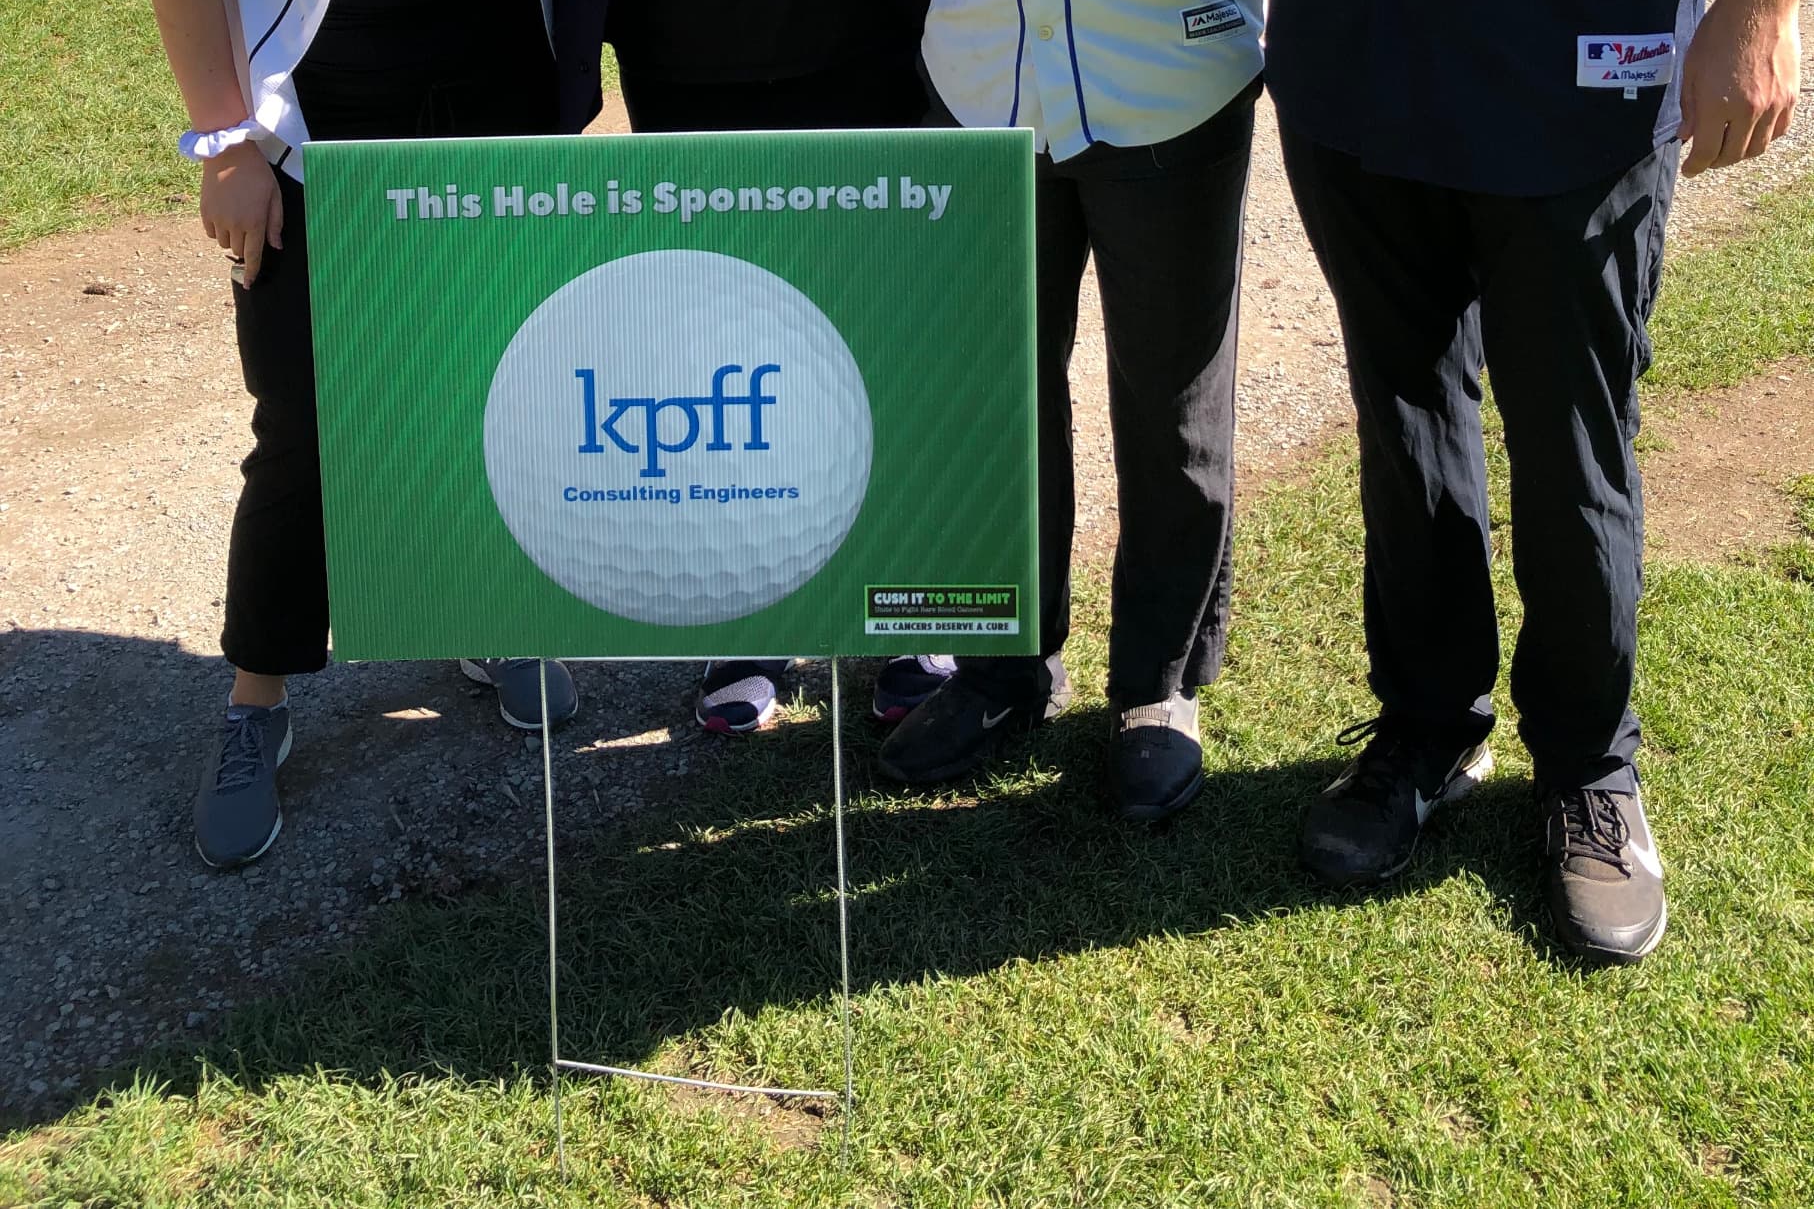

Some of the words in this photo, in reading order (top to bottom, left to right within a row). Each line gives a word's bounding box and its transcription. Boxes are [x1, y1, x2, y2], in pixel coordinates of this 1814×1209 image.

[1619, 41, 1670, 65] Authentic
[1621, 70, 1657, 81] Majestic
[387, 184, 482, 220] This
[493, 185, 596, 217] Hole
[607, 180, 643, 214] is
[652, 176, 889, 222] Sponsored
[899, 176, 952, 220] by
[574, 363, 781, 478] kpff
[563, 485, 681, 504] Consulting
[689, 484, 800, 503] Engineers
[874, 593, 908, 604] CUSH
[911, 593, 924, 604] IT
[927, 593, 945, 604] TO
[948, 593, 972, 604] THE
[976, 593, 1010, 604] LIMIT
[874, 622, 890, 631] ALL
[892, 622, 932, 631] CANCERS
[935, 622, 973, 631] DESERVE
[976, 622, 983, 631] A
[986, 622, 1009, 631] CURE
